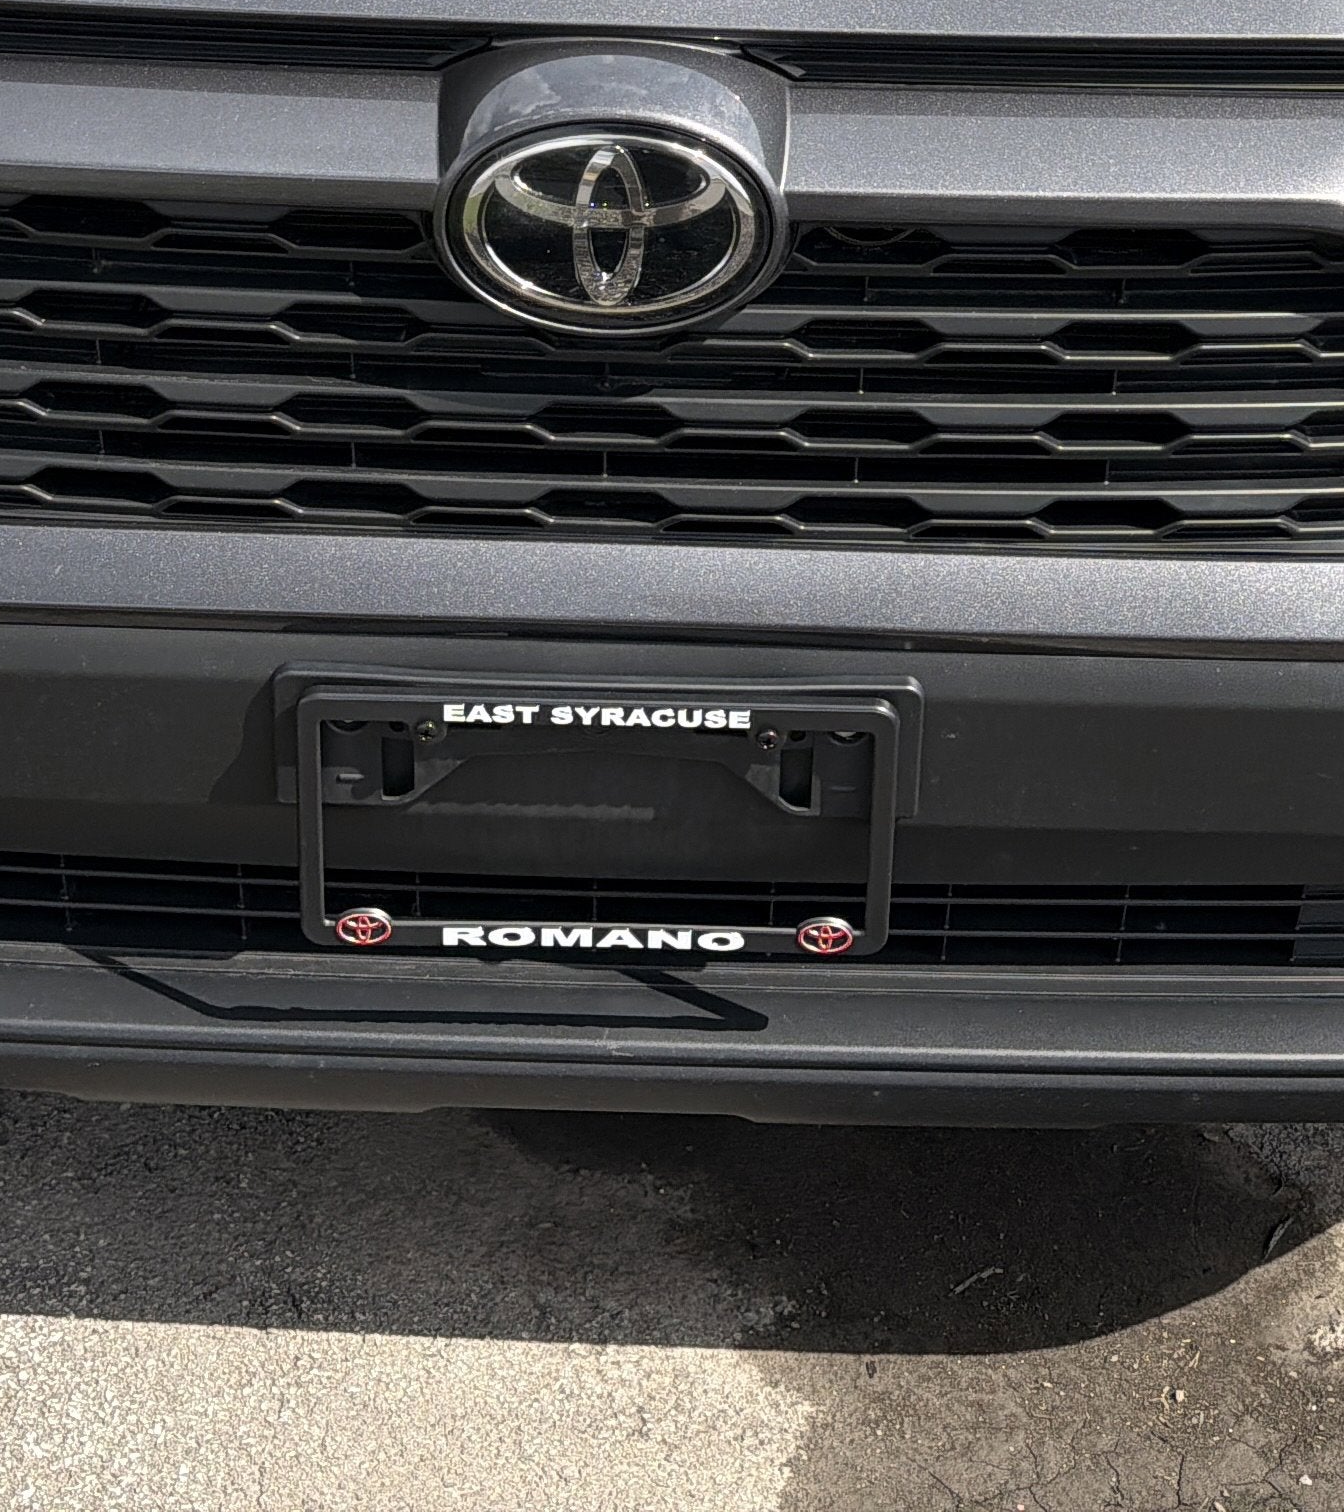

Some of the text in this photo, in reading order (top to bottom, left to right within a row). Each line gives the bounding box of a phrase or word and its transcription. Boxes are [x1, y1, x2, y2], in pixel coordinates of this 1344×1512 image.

[444, 704, 750, 728] EAST SYRACUSE
[443, 927, 744, 951] ROMANO
